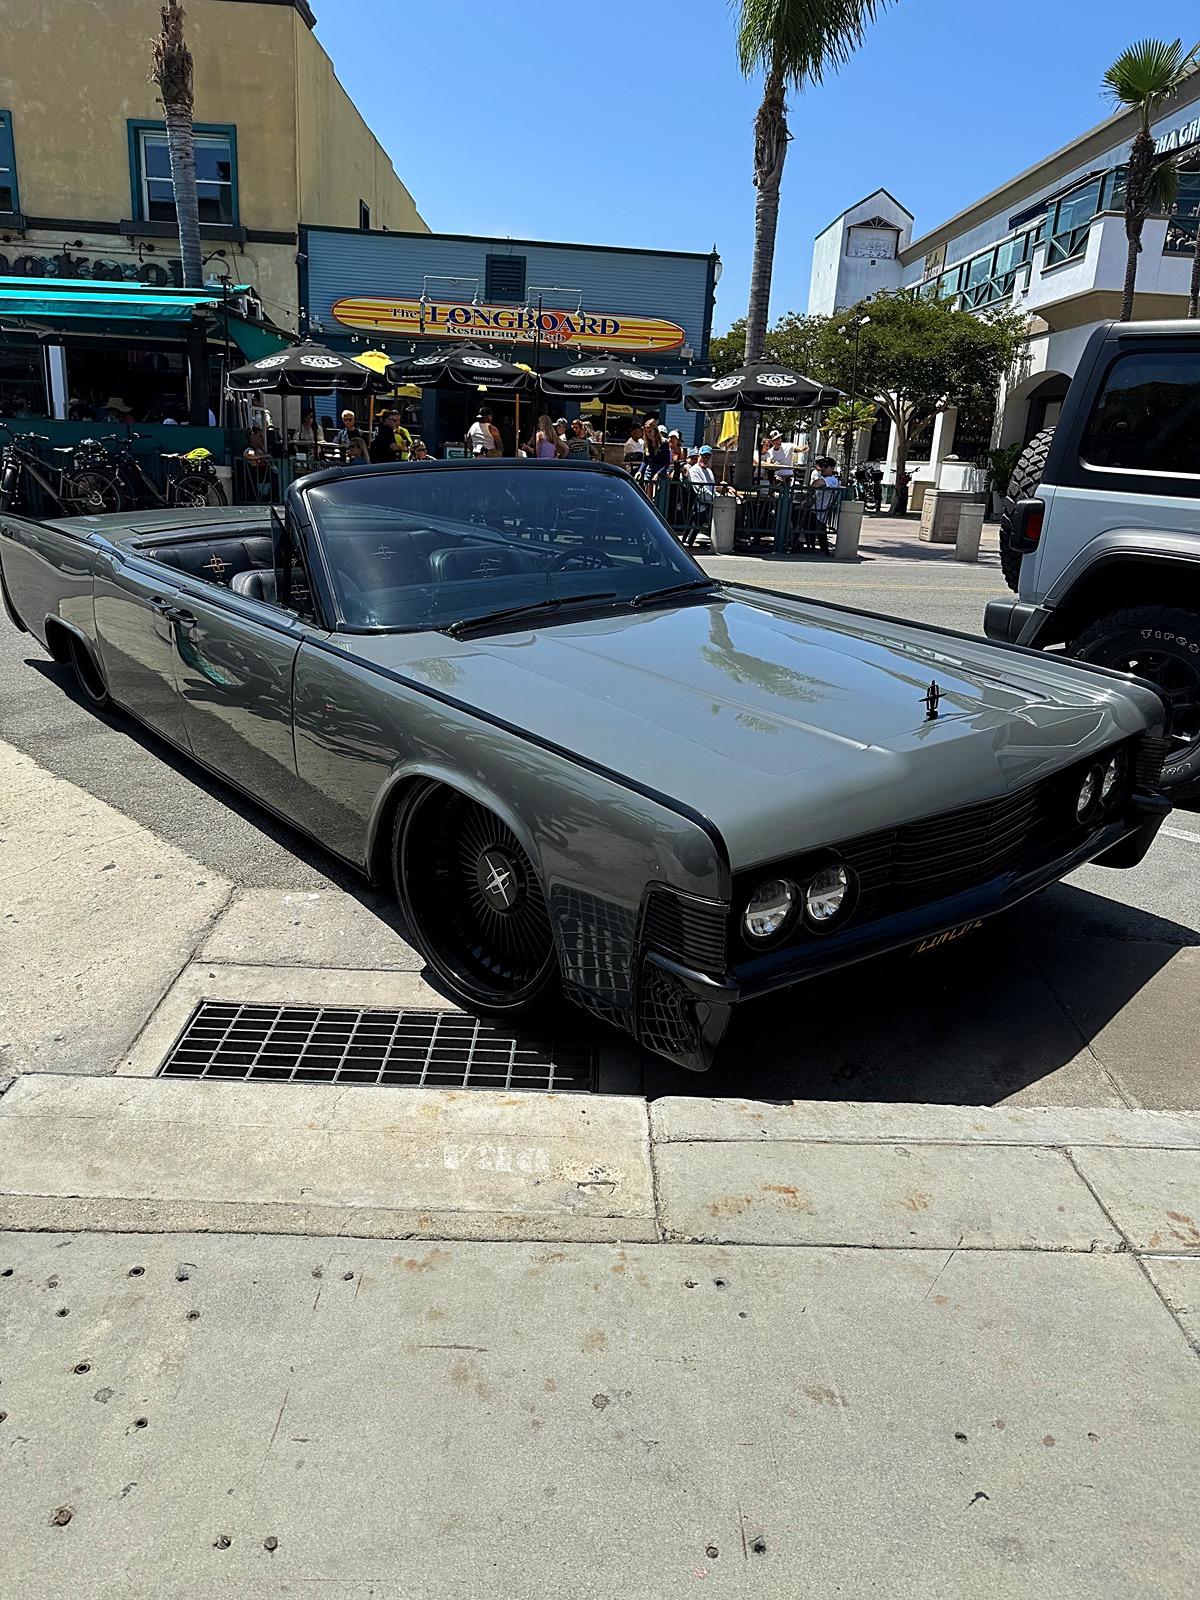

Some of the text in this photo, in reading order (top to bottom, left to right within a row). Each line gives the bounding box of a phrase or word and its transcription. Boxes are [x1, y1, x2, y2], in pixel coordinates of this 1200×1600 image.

[389, 305, 621, 335] The LONGBOARD
[446, 323, 519, 339] Restaurant
[540, 330, 567, 343] Pub
[495, 352, 513, 362] 217
[755, 373, 798, 388] 805
